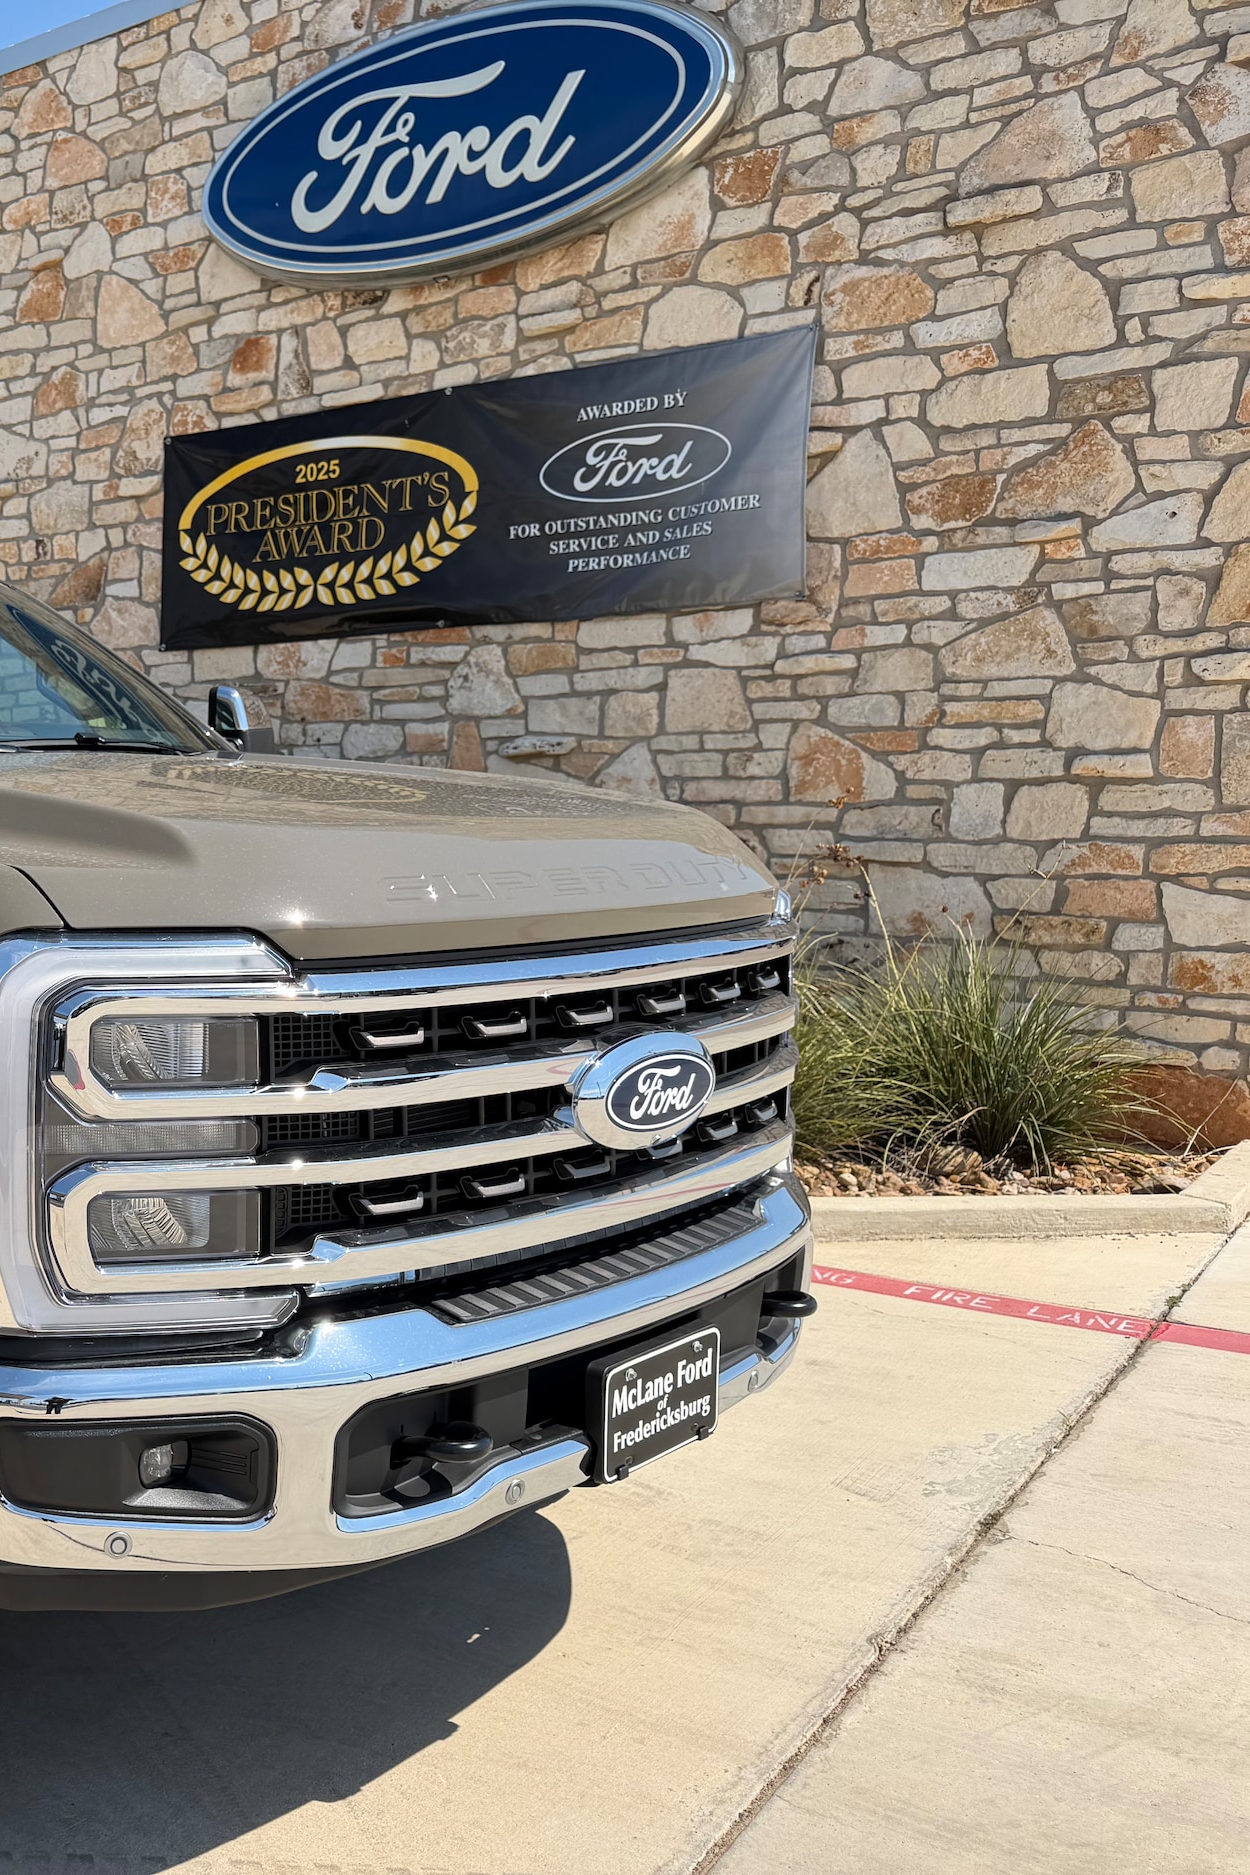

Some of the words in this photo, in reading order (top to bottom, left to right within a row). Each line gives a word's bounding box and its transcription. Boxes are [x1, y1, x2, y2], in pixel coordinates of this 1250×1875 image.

[291, 60, 586, 233] Ford
[576, 396, 659, 423] AWARDED
[663, 391, 688, 410] BY
[295, 459, 341, 484] 2025
[573, 433, 694, 493] Ford
[206, 471, 451, 536] PRESIDENT'S
[508, 522, 541, 540] FOR
[544, 508, 663, 535] OUTSTANDING
[668, 494, 762, 522] CUSTOMER
[251, 516, 385, 563] AWARD
[549, 534, 620, 555] SERVICE
[623, 529, 660, 548] AND
[662, 520, 714, 543] SALES
[567, 545, 692, 573] PERFORMANCE
[629, 1065, 696, 1120] Ford
[902, 1284, 1003, 1311] FIRE
[1026, 1304, 1144, 1334] LANE
[611, 1372, 674, 1419] McLane
[676, 1347, 713, 1388] Ford
[656, 1393, 669, 1411] of
[612, 1394, 712, 1454] Fredericksburg
